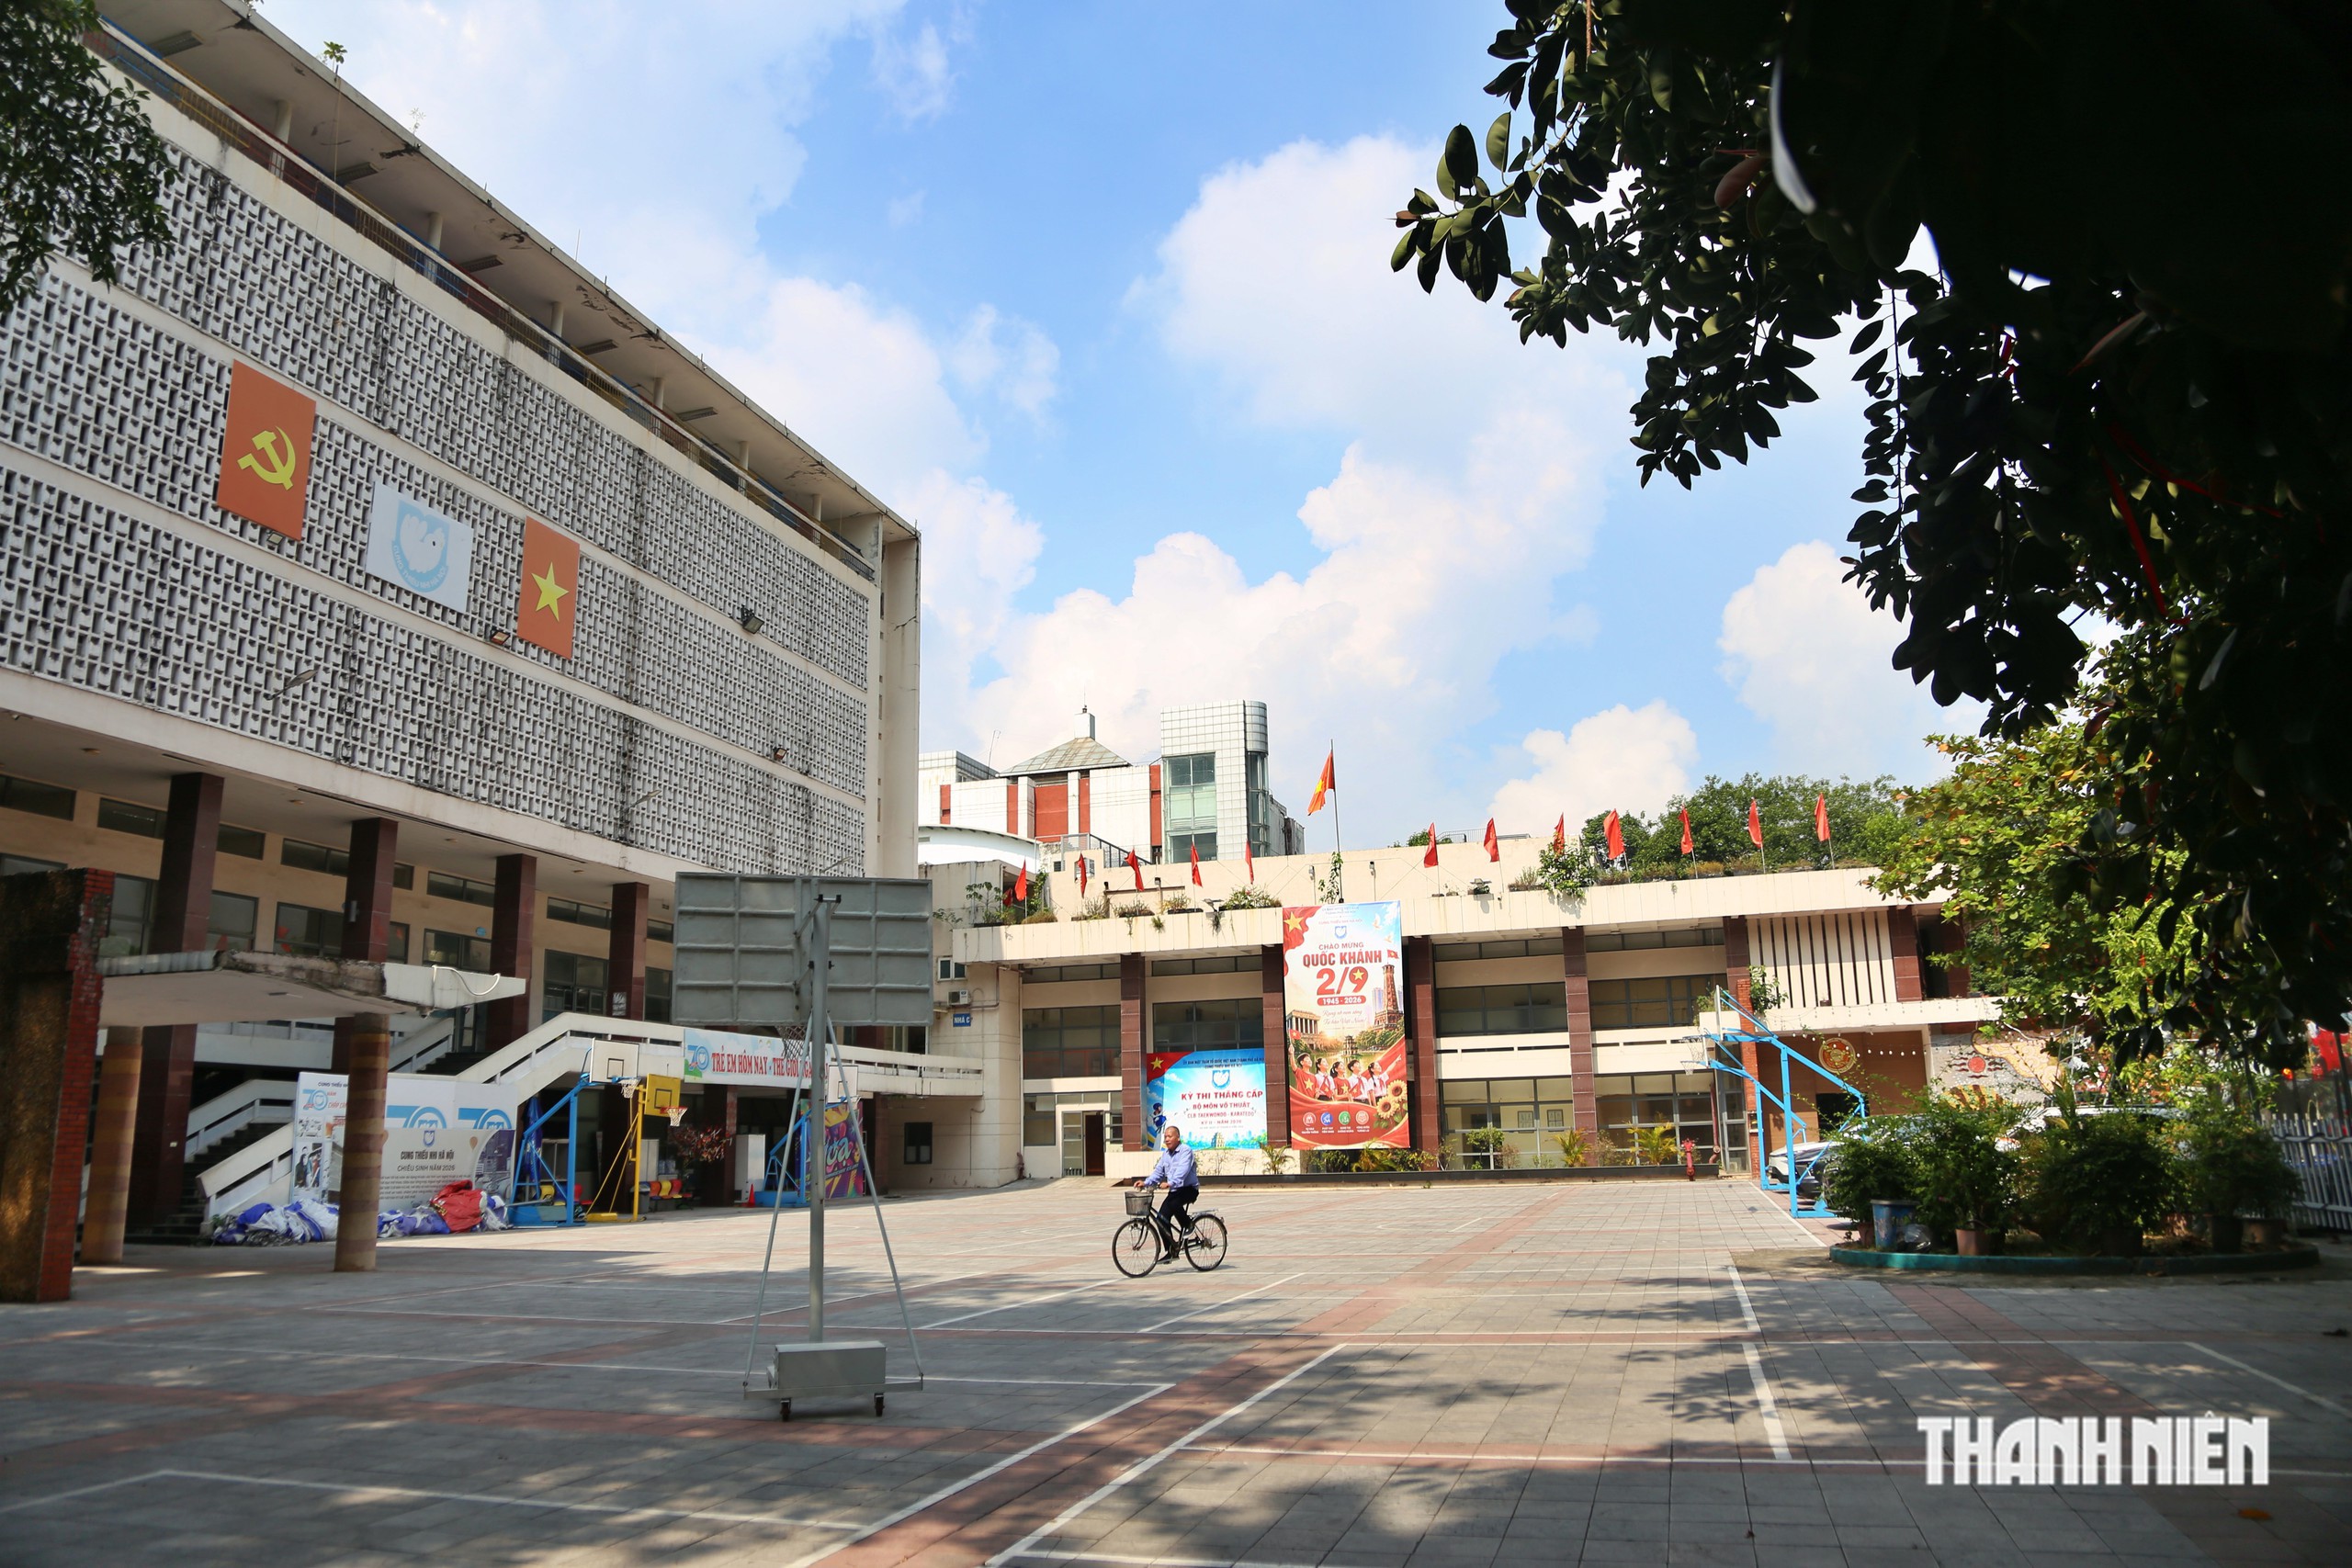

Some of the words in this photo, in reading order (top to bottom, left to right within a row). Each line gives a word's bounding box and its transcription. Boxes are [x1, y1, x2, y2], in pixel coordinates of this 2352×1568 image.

[1303, 950, 1335, 968] QUỐC
[1340, 949, 1382, 965] KHÁNH
[1316, 966, 1368, 996] 2/9
[954, 1015, 965, 1023] NHÀ
[712, 1045, 725, 1072] TRẺ
[727, 1054, 736, 1073] EM
[738, 1050, 753, 1074] HÔM
[754, 1056, 768, 1075] NAY
[1182, 1092, 1193, 1100] KỲ
[1247, 1089, 1263, 1098] CẤP
[401, 1151, 413, 1160] CUNG
[415, 1150, 428, 1160] THIẾU
[429, 1151, 437, 1160] NHI
[438, 1150, 445, 1160] HÀ
